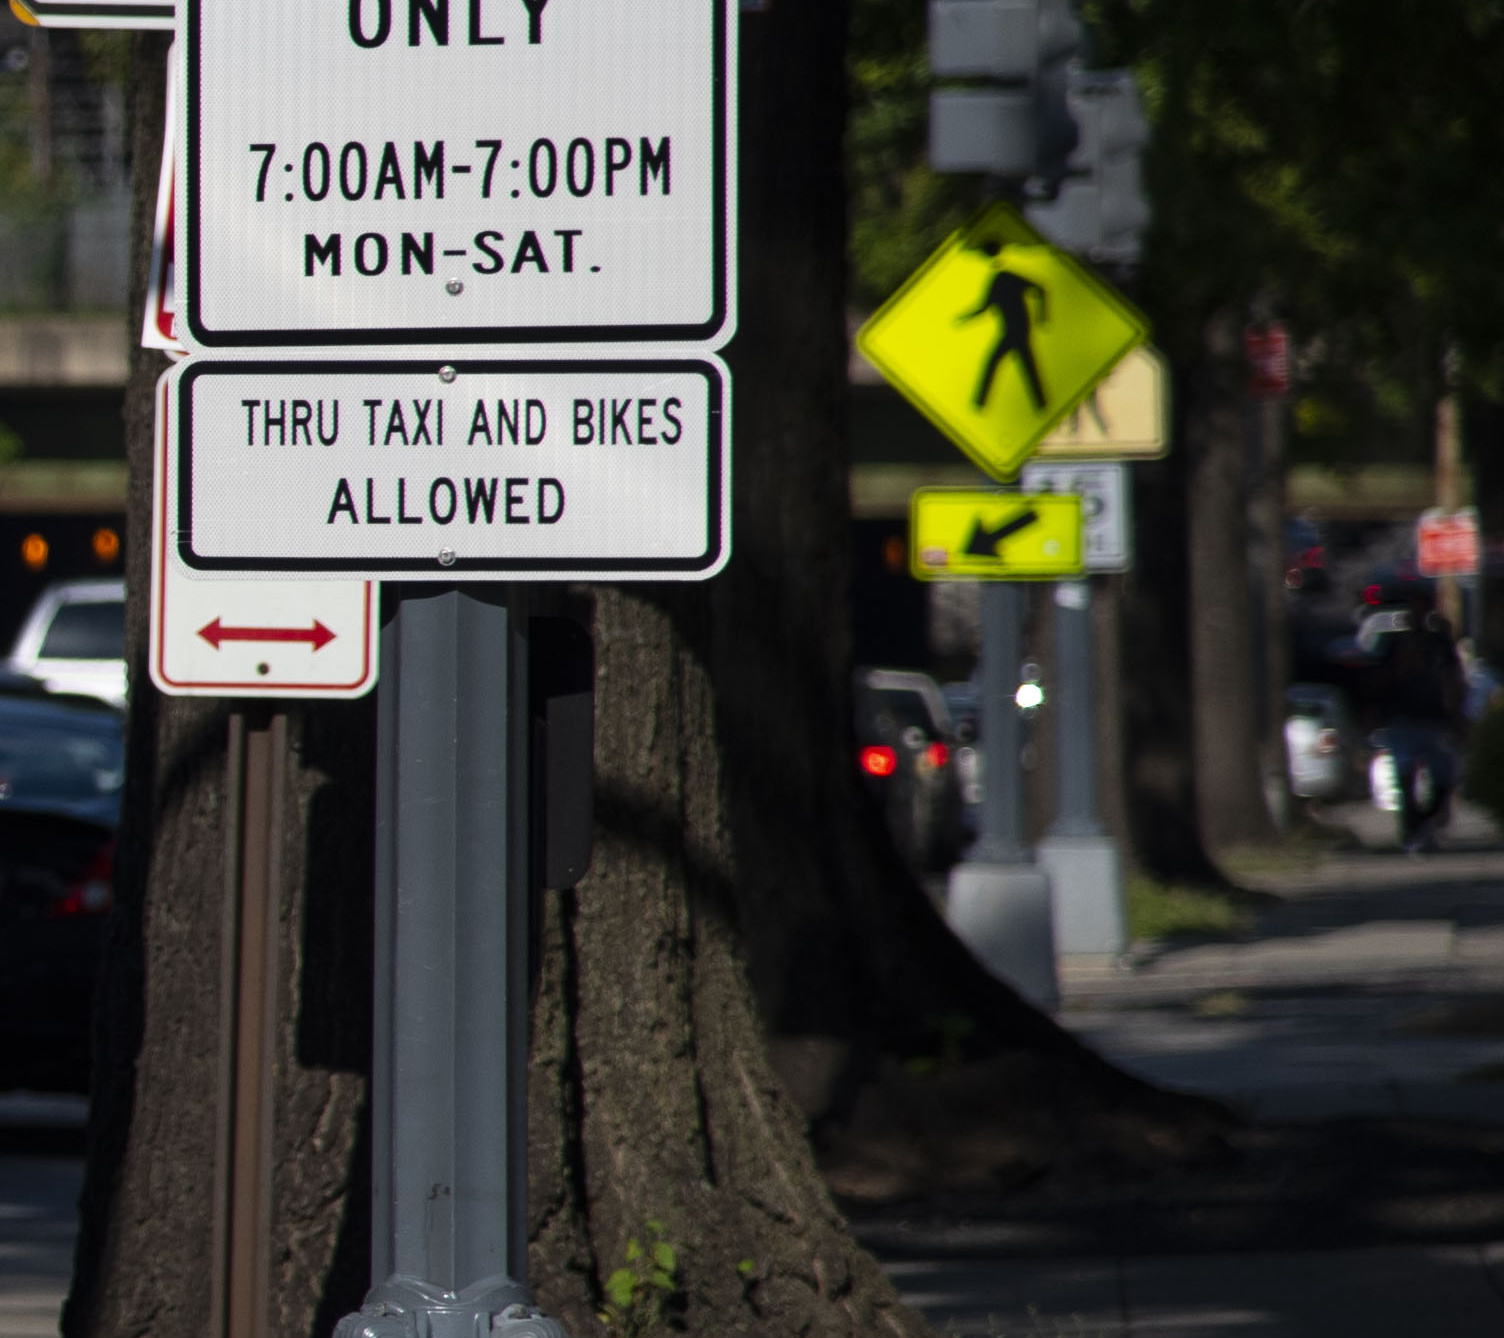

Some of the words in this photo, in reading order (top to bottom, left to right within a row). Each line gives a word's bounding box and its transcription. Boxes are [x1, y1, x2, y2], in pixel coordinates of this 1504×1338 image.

[248, 136, 673, 202] 7:00AM-7:00PM
[303, 228, 604, 277] MON-SAT.
[241, 398, 341, 447] THRU
[362, 398, 445, 447] TAXI
[467, 399, 548, 446] AND
[571, 397, 684, 447] BIKES
[326, 475, 567, 526] ALLOWED
